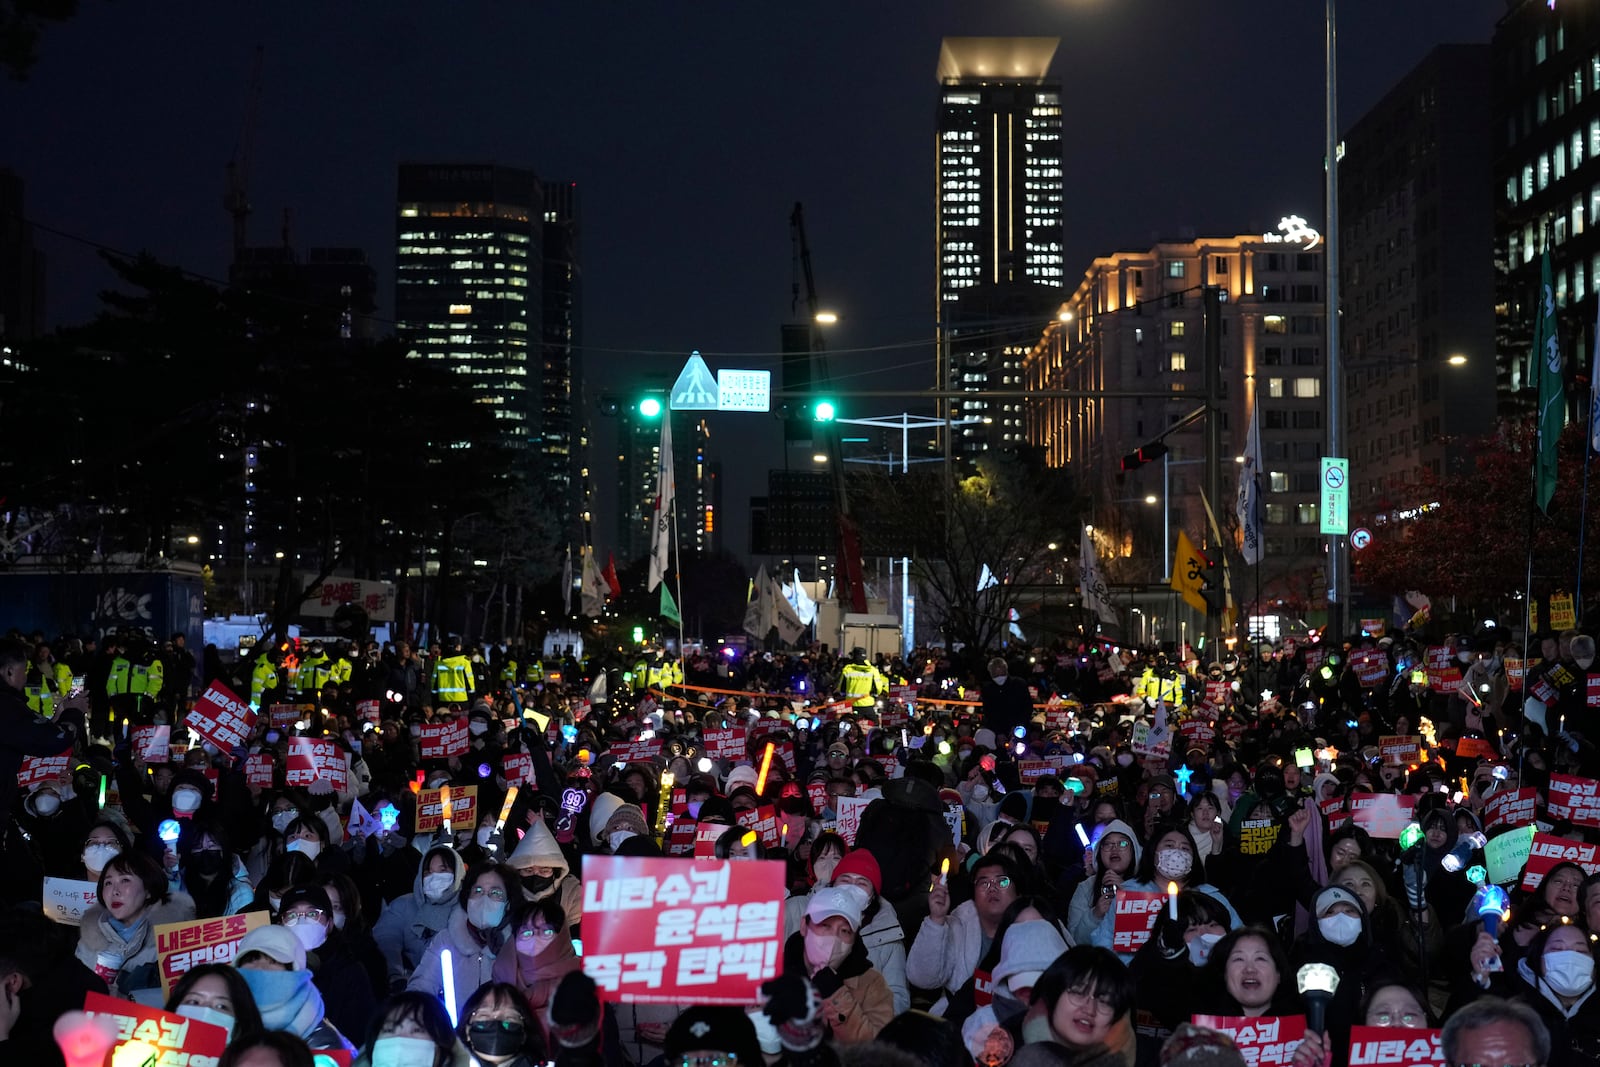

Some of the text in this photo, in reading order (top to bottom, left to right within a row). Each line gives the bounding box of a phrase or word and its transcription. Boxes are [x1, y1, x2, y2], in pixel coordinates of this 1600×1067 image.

[202, 687, 249, 719] 내란수괴
[421, 720, 458, 738] 내란수괴
[440, 727, 469, 746] 윤석열
[703, 730, 733, 742] 내란수괴
[288, 743, 335, 756] 내란수괴
[421, 736, 469, 756] 즉각 탄핵!
[717, 738, 745, 750] 윤석열
[722, 746, 745, 757] 탄핵!
[29, 756, 69, 769] 윤석열
[312, 755, 346, 771] 윤석열
[287, 769, 315, 783] 즉각
[418, 787, 465, 805] 내란조
[1550, 780, 1598, 796] 내란수괴
[566, 792, 582, 807] 99
[1485, 790, 1519, 816] 내란수괴
[1498, 798, 1535, 816] 윤석열
[419, 809, 473, 829] 해체라!
[1506, 808, 1535, 825] 탄핵!
[1547, 803, 1571, 819] 즉각
[1240, 824, 1282, 842] 국민의
[1241, 819, 1271, 829] 내란공범
[1240, 840, 1277, 855] 해체
[1530, 842, 1597, 863] 내란수괴
[583, 860, 731, 912] 내란수괴
[1522, 872, 1545, 889] 즉
[83, 891, 97, 904] 탄
[1116, 896, 1167, 915] 내란수
[655, 900, 780, 947] 윤석열
[158, 914, 246, 954] 내란동조
[169, 939, 242, 972] 국민의
[583, 940, 779, 992] 즉각 탄핵!
[88, 1011, 190, 1049] 란수괴
